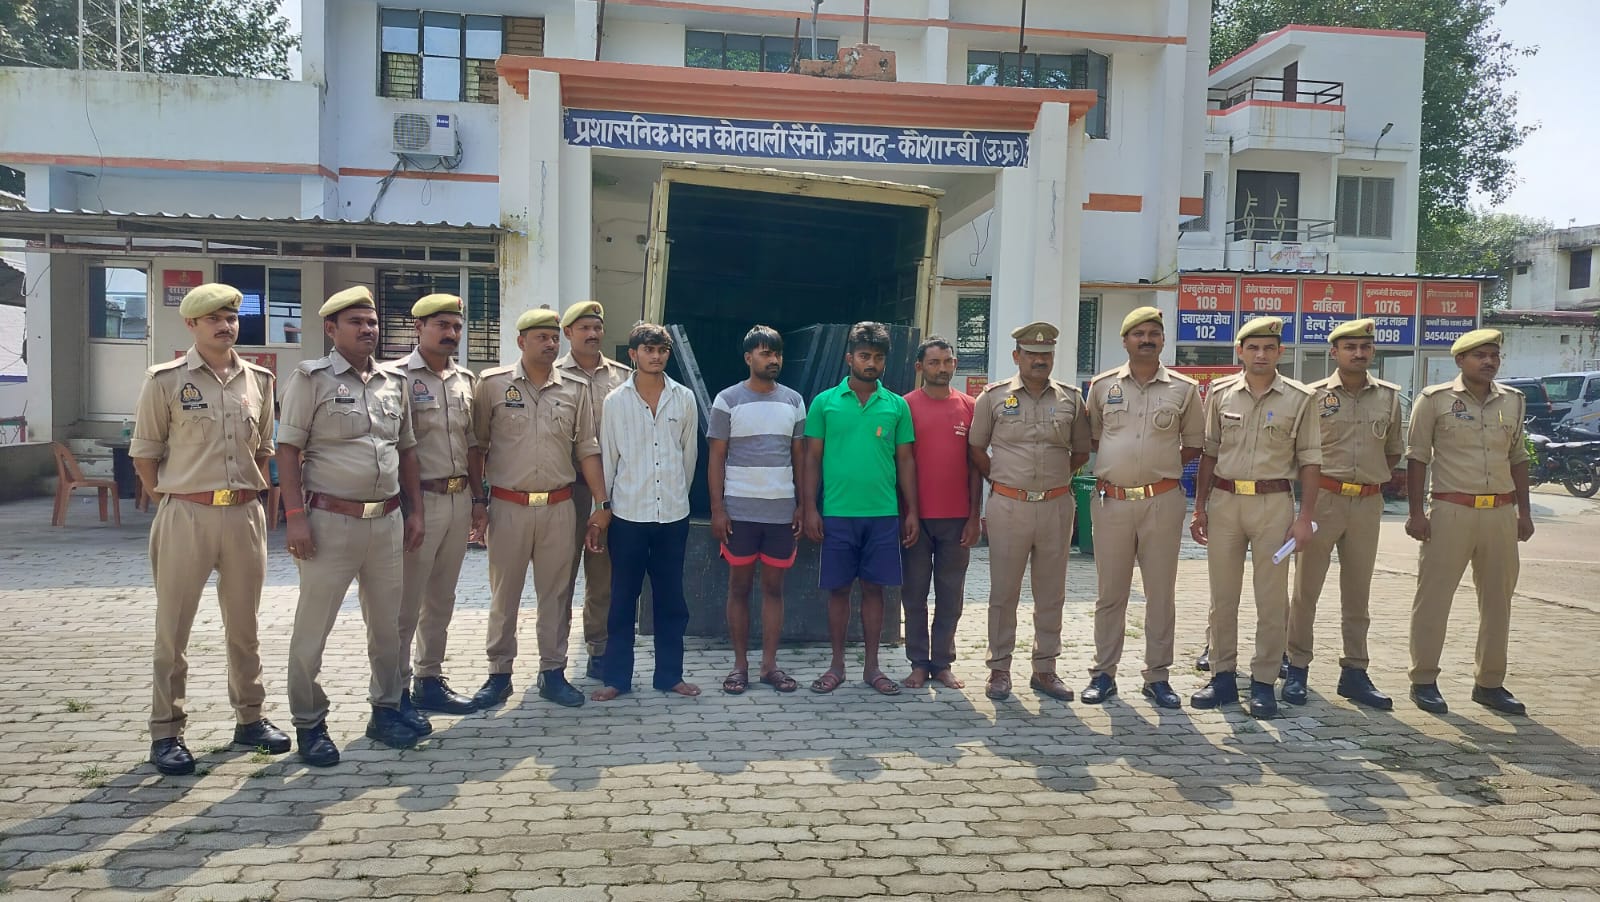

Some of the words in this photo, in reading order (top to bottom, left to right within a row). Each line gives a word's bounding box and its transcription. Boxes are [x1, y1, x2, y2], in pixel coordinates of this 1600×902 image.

[572, 114, 669, 146] प्रशासनिक
[670, 123, 713, 150] भवन
[713, 119, 787, 155] कोतवाली
[1217, 282, 1233, 295] सेवा
[1196, 296, 1218, 310] 108
[1253, 297, 1282, 311] 1090
[1312, 297, 1346, 313] महिला
[1374, 300, 1401, 314] 1076
[1441, 301, 1457, 313] 112
[1181, 313, 1213, 324] स्वास्थ्य
[1214, 312, 1231, 325] सेवा
[1305, 316, 1327, 331] हेल्प
[1195, 326, 1216, 339] 102
[1374, 329, 1401, 342] 1098
